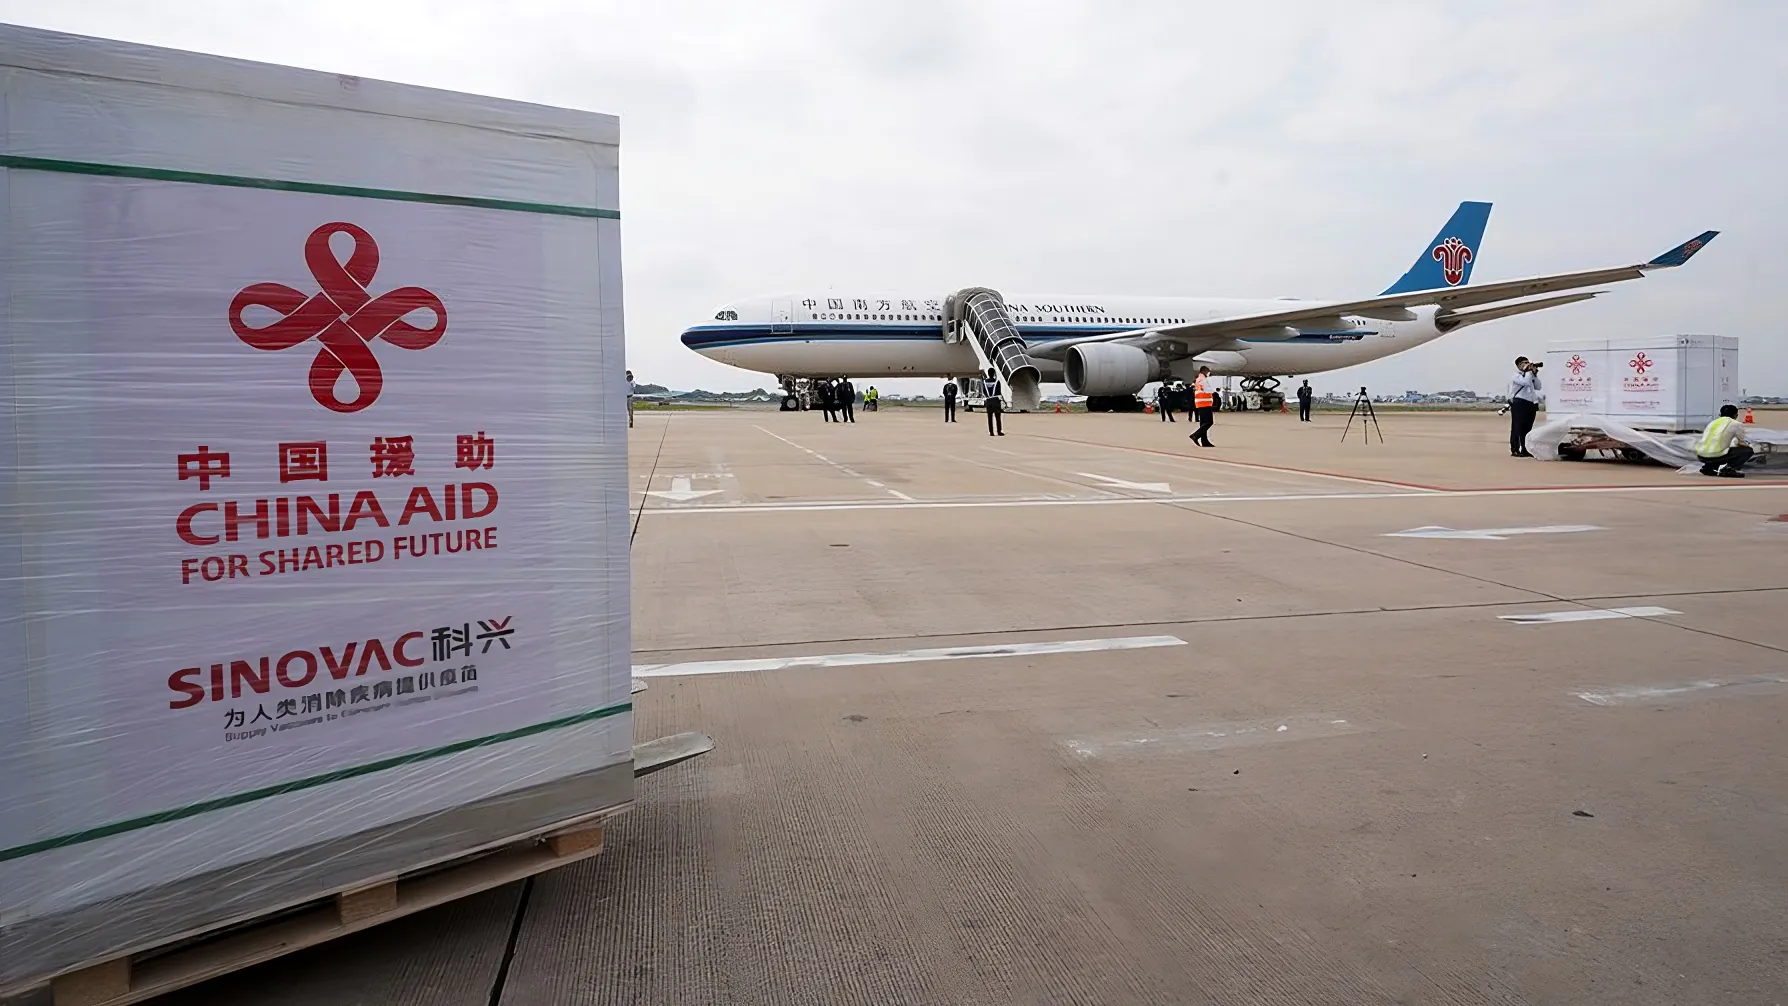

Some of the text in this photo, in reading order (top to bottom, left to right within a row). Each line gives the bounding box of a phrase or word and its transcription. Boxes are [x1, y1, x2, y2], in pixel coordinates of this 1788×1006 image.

[177, 431, 495, 490] 中国援助
[176, 482, 499, 546] CHINA AID
[181, 526, 498, 584] FOR SHARED FUTURE
[168, 616, 515, 709] SINOVAC 科兴
